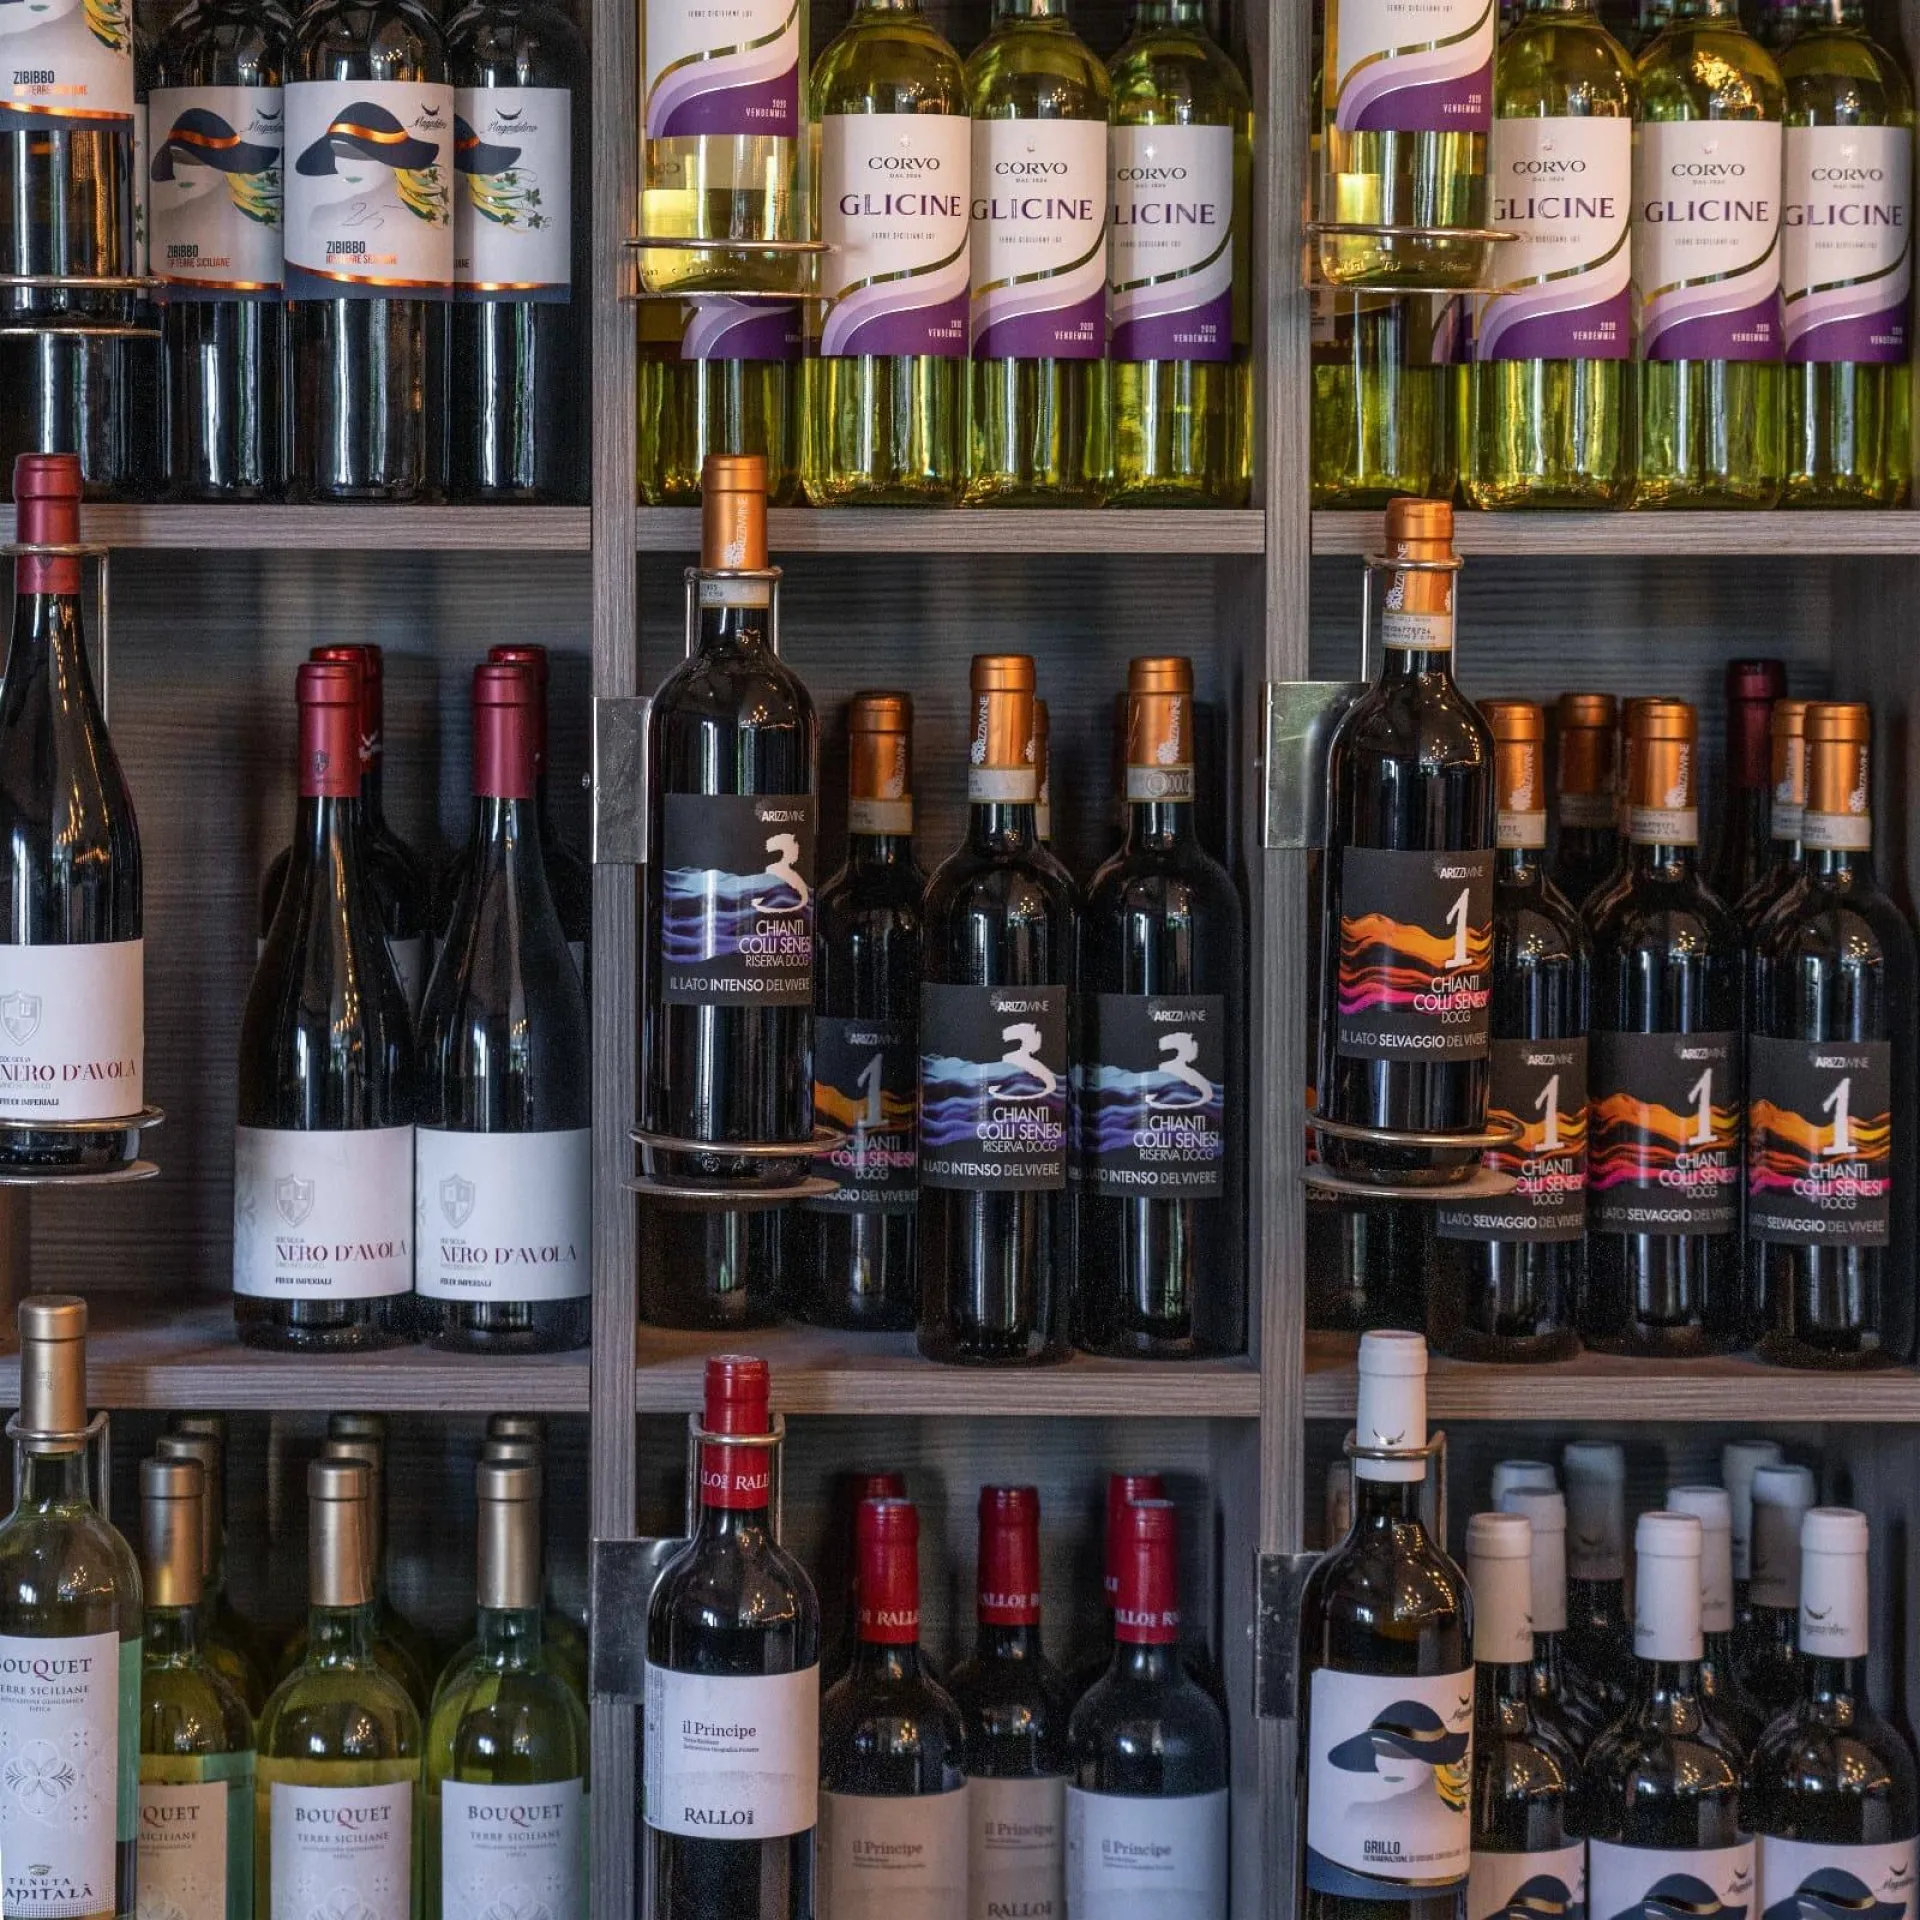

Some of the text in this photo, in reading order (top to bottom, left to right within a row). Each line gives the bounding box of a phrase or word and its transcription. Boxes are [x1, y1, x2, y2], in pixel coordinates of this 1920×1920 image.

[13, 70, 55, 84] ZIBIBBO
[745, 107, 787, 118] VENDEMMIA
[867, 156, 940, 171] CORVO
[995, 161, 1068, 175] CORVO
[1511, 160, 1586, 175] CORVO
[1671, 163, 1746, 176] CORVO
[1117, 166, 1188, 181] CORVO
[1811, 168, 1884, 181] CORVO
[839, 194, 961, 217] GLICINE
[971, 198, 1094, 221] GLICINE
[1494, 197, 1615, 220] GLICINE
[1645, 200, 1769, 222] GLICINE
[1112, 203, 1216, 225] LICINE
[1786, 204, 1903, 226] GLICINE
[167, 244, 199, 258] ZIBIBBO
[326, 240, 366, 254] ZIBIBBO
[1572, 331, 1616, 341] VENDEMMIA
[761, 811, 805, 822] ARIZZIWINE
[1440, 867, 1484, 879] ARIZZIWINE
[755, 920, 804, 937] CHIANTI
[738, 937, 812, 954] COLLI SENESI
[745, 955, 809, 967] RISERVA DOCG
[680, 977, 708, 991] LATO
[710, 978, 764, 991] INTENSO
[766, 979, 786, 991] DEL
[1431, 975, 1480, 991] CHIANTI
[998, 1001, 1049, 1012] ARIZZIWINE
[1413, 994, 1452, 1010] COLLI
[1154, 1009, 1206, 1021] ARIZZIWINE
[1441, 1010, 1471, 1023] DOCG
[1350, 1032, 1377, 1045] LATO
[1379, 1034, 1446, 1048] SELVAGGIO
[1447, 1034, 1463, 1047] DEL
[1527, 1054, 1574, 1066] ARIZZIWINE
[1815, 1056, 1870, 1068] ARIZZIWINE
[1, 1059, 137, 1081] NERO D'AVOLA
[992, 1106, 1050, 1123] CHIANTI
[976, 1122, 1063, 1140] COLLI SENESI
[1149, 1115, 1206, 1131] CHIANTI
[982, 1140, 1058, 1153] RISERVA DOCG
[1133, 1132, 1219, 1149] COLLI SENESI
[868, 1151, 915, 1167] SENESI
[1139, 1149, 1214, 1161] RISERVA DOCG
[1675, 1152, 1728, 1169] CHIANTI
[951, 1163, 1002, 1177] INTENSO
[1003, 1163, 1026, 1176] DEL
[1027, 1162, 1060, 1176] VIVERE
[1521, 1158, 1574, 1176] CHIANTI
[1808, 1162, 1868, 1179] CHIANTI
[1109, 1170, 1158, 1184] INTENSO
[1160, 1171, 1182, 1185] DEL
[1183, 1170, 1218, 1185] VIVERE
[1516, 1176, 1545, 1193] OLLI
[1658, 1169, 1697, 1187] COLLI
[1686, 1186, 1718, 1199] DOCG
[1792, 1178, 1883, 1196] COLLI SENESI
[1532, 1193, 1565, 1206] DOCG
[1820, 1197, 1857, 1210] DOCG
[1446, 1211, 1471, 1225] LATO
[1472, 1213, 1538, 1228] SELVAGGIO
[1538, 1214, 1556, 1228] DEL
[1627, 1208, 1693, 1223] SELVAGGIO
[1767, 1216, 1826, 1232] SELVAGGIO
[1827, 1219, 1849, 1232] DEL
[1849, 1219, 1885, 1232] VIVERE
[276, 1239, 408, 1262] NERO D'AVOLA
[440, 1243, 577, 1264] NERO D'AVOLA
[734, 1474, 768, 1491] RALL
[877, 1610, 918, 1627] RALL
[30, 1685, 88, 1695] SICILIANE
[682, 1720, 757, 1739] il Principe
[143, 1805, 200, 1828] QUET
[295, 1805, 391, 1830] BOUQUET
[467, 1804, 563, 1828] BOUQUET
[298, 1832, 391, 1842] TERRE SICILIANE
[470, 1829, 561, 1841] TERRE SICILIANE
[864, 1841, 923, 1857] Principe
[1114, 1840, 1172, 1858] Principe
[1363, 1840, 1401, 1855] GRILLO
[9, 1877, 72, 1887] TENUTA
